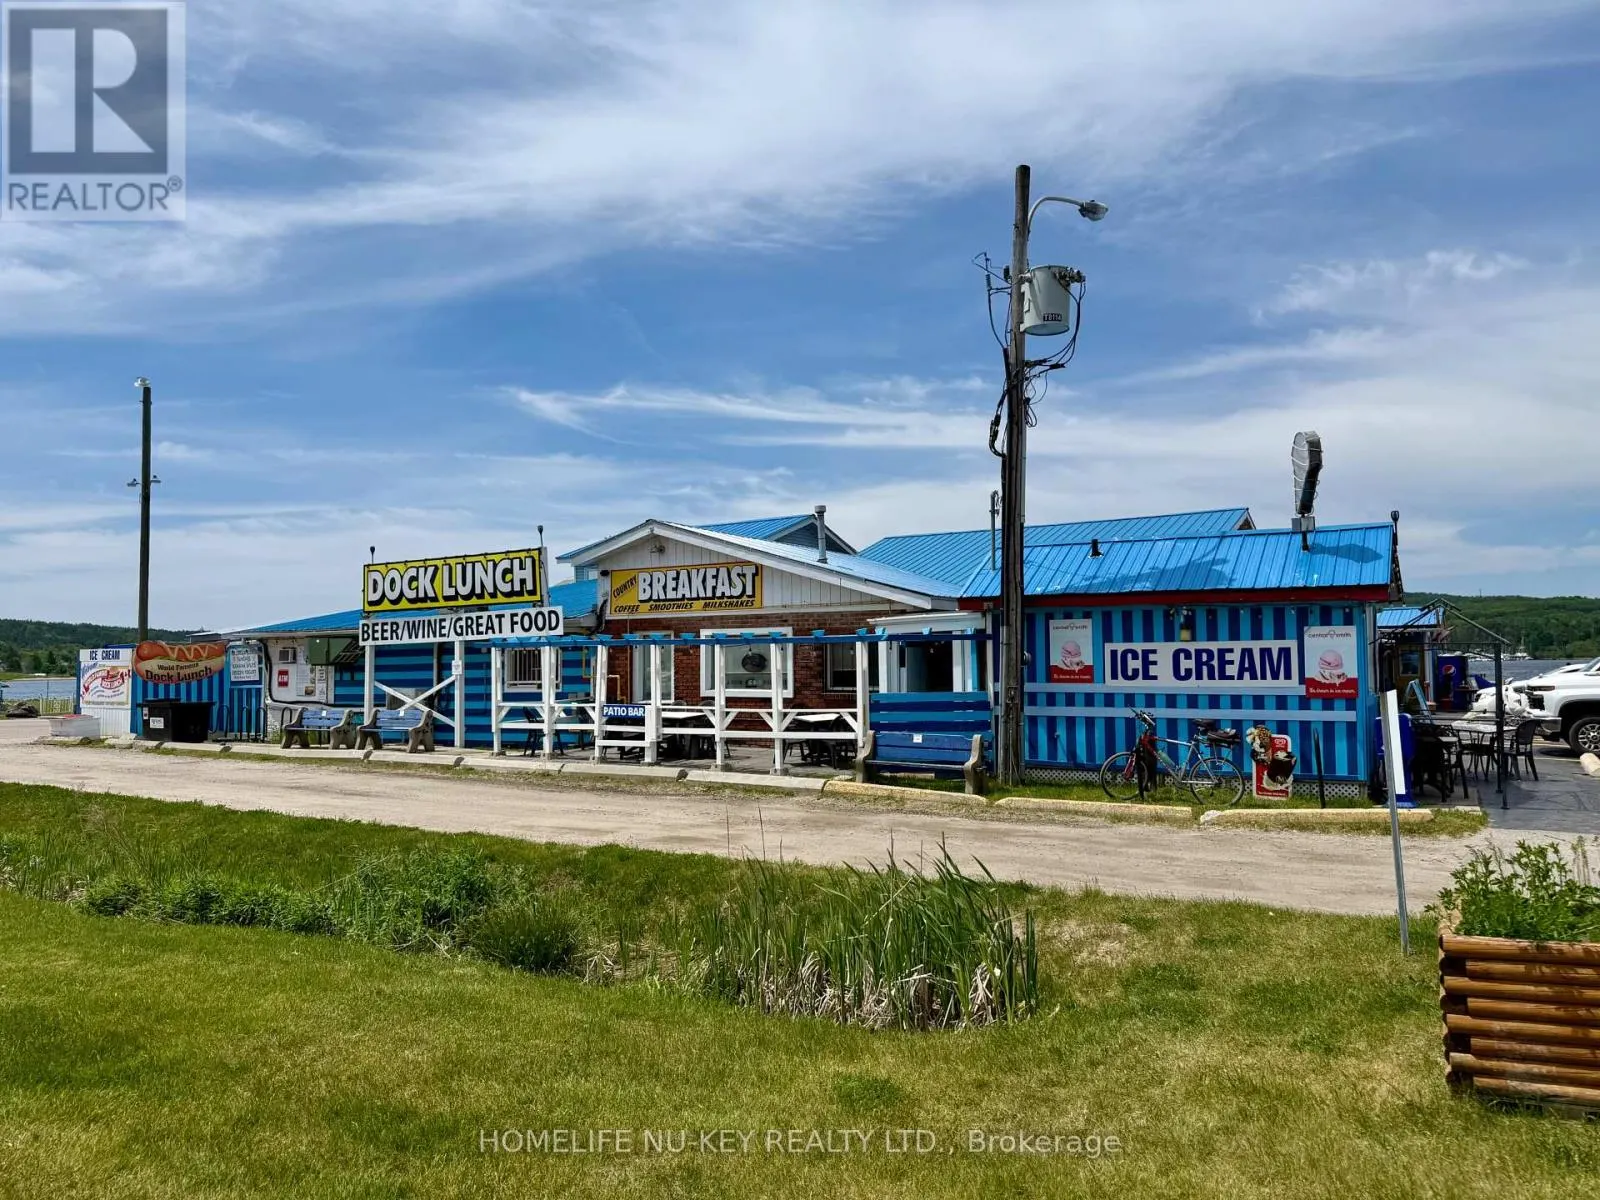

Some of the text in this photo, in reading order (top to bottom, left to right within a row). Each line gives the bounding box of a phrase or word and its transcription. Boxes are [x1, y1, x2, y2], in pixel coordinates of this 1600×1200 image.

[367, 557, 535, 606] DOCK LUNCH
[613, 574, 637, 599] COUNTRY
[638, 564, 758, 603] BREAKFAST
[614, 599, 755, 614] COFFEE SMOOTHIES MILKSHAKES
[361, 609, 560, 642] BEER/WINE/GREAT FOOD
[90, 650, 120, 660] ICE CREAM
[1110, 647, 1292, 681] ICE CREAM
[145, 669, 174, 682] Dock
[177, 665, 212, 681] Lunch
[603, 706, 645, 717] PATIO BAR
